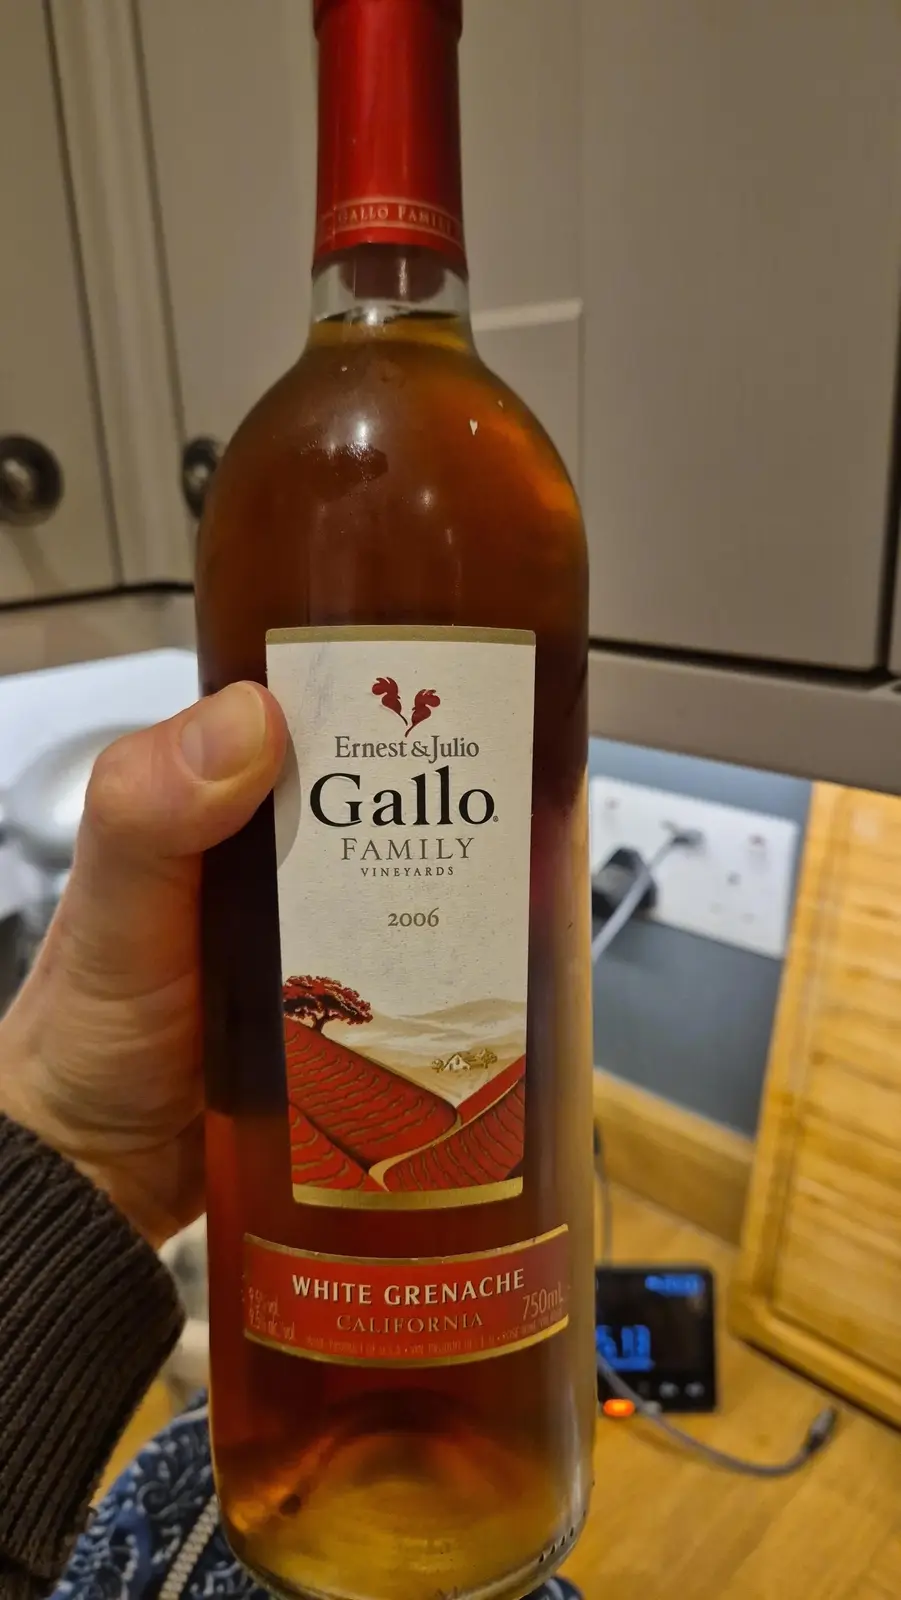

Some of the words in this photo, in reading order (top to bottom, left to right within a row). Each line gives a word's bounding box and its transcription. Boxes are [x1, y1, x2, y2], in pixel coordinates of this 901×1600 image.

[335, 735, 407, 758] Ernest
[411, 740, 431, 757] &
[428, 735, 480, 763] Julio
[309, 765, 495, 828] Gallo
[341, 837, 474, 861] FAMILY
[361, 866, 454, 877] VINEYARDS
[387, 907, 440, 928] 2006
[292, 1274, 372, 1305] WHITE
[384, 1268, 525, 1306] GRENACHE
[336, 1312, 483, 1334] CALIFORNIA
